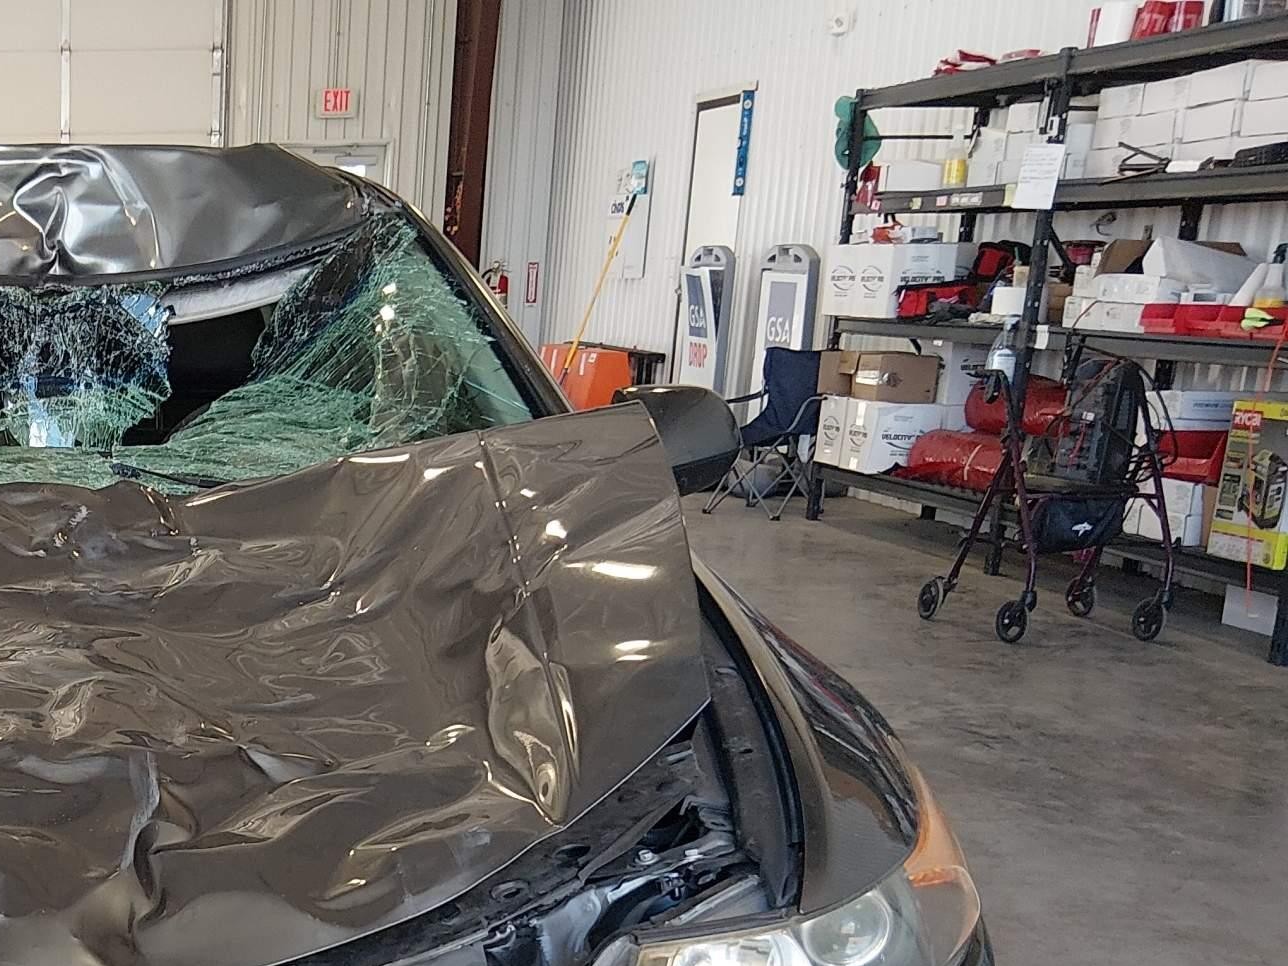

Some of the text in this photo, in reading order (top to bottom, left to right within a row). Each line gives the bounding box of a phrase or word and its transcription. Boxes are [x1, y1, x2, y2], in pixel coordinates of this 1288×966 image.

[324, 90, 350, 112] EXIT
[690, 304, 707, 329] GSA
[766, 315, 791, 343] GSA
